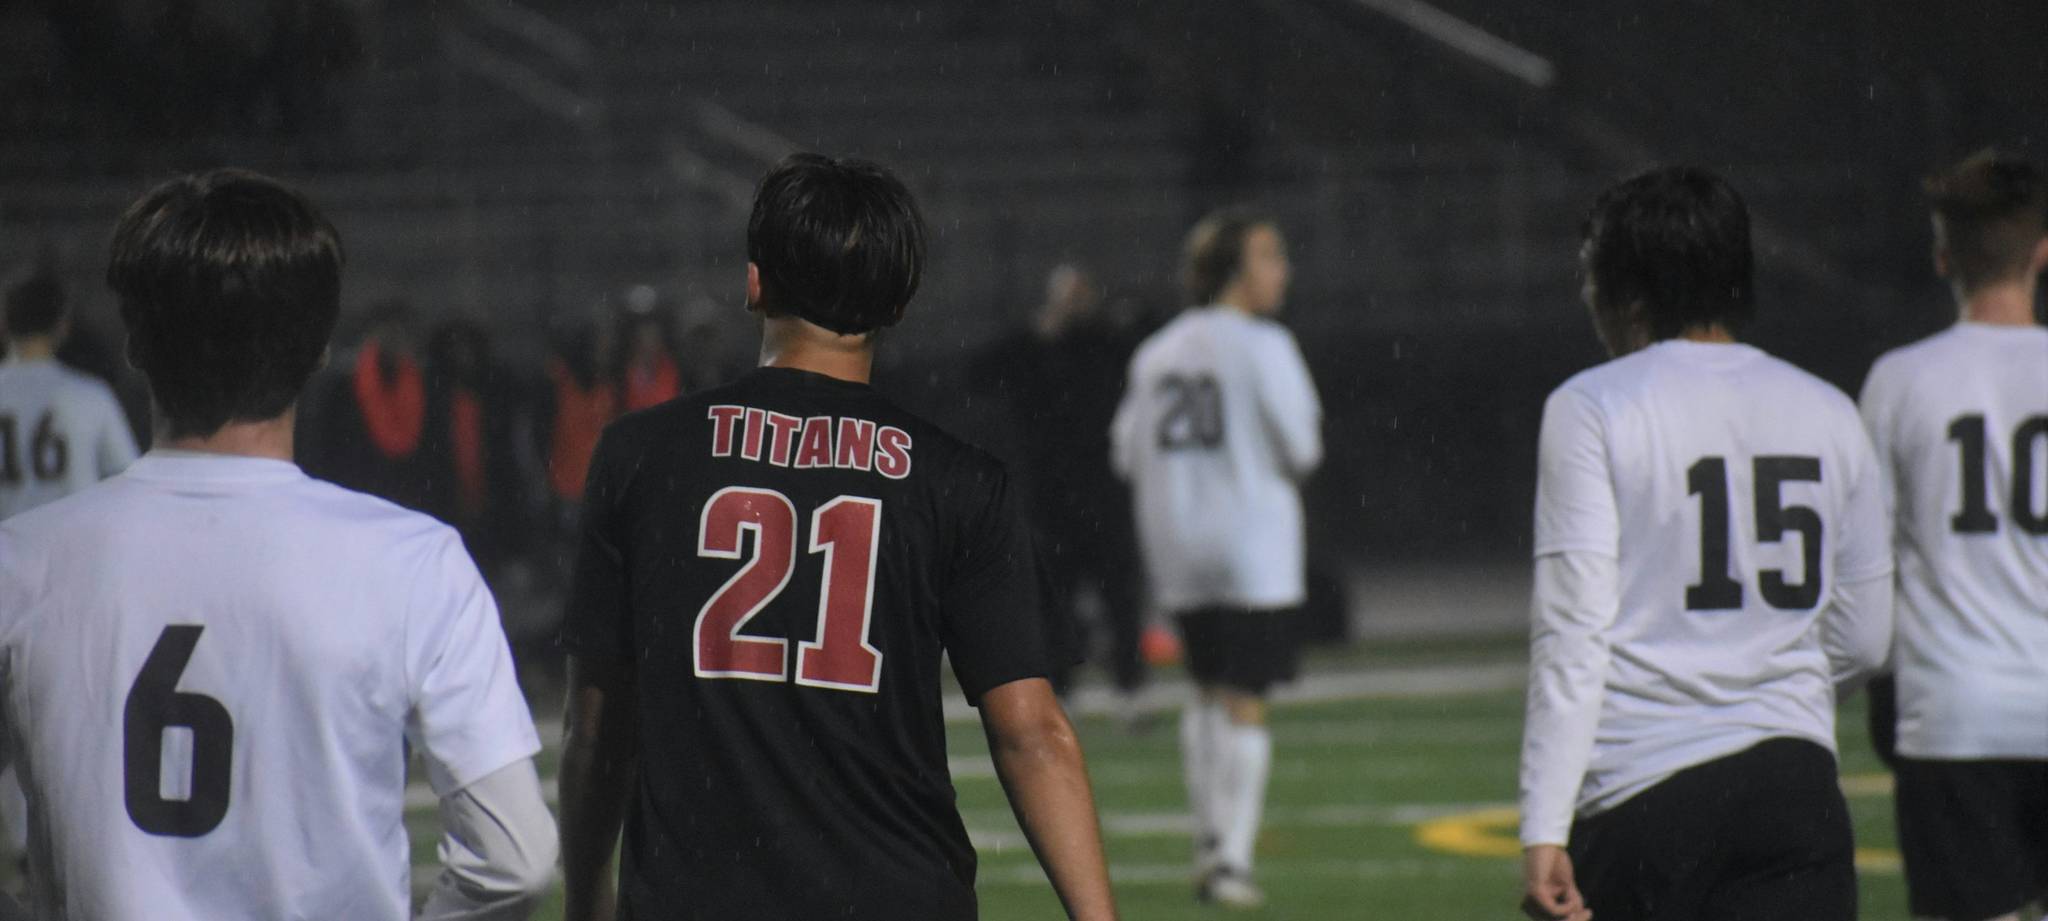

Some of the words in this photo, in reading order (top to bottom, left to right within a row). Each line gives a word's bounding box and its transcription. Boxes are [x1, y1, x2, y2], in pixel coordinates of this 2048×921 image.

[0, 409, 69, 485] 16
[708, 405, 912, 480] TITANS
[1155, 374, 1225, 452] 20
[1947, 413, 2048, 536] 10
[693, 486, 883, 693] 21
[1686, 456, 1823, 612] 15
[123, 624, 234, 838] 6
